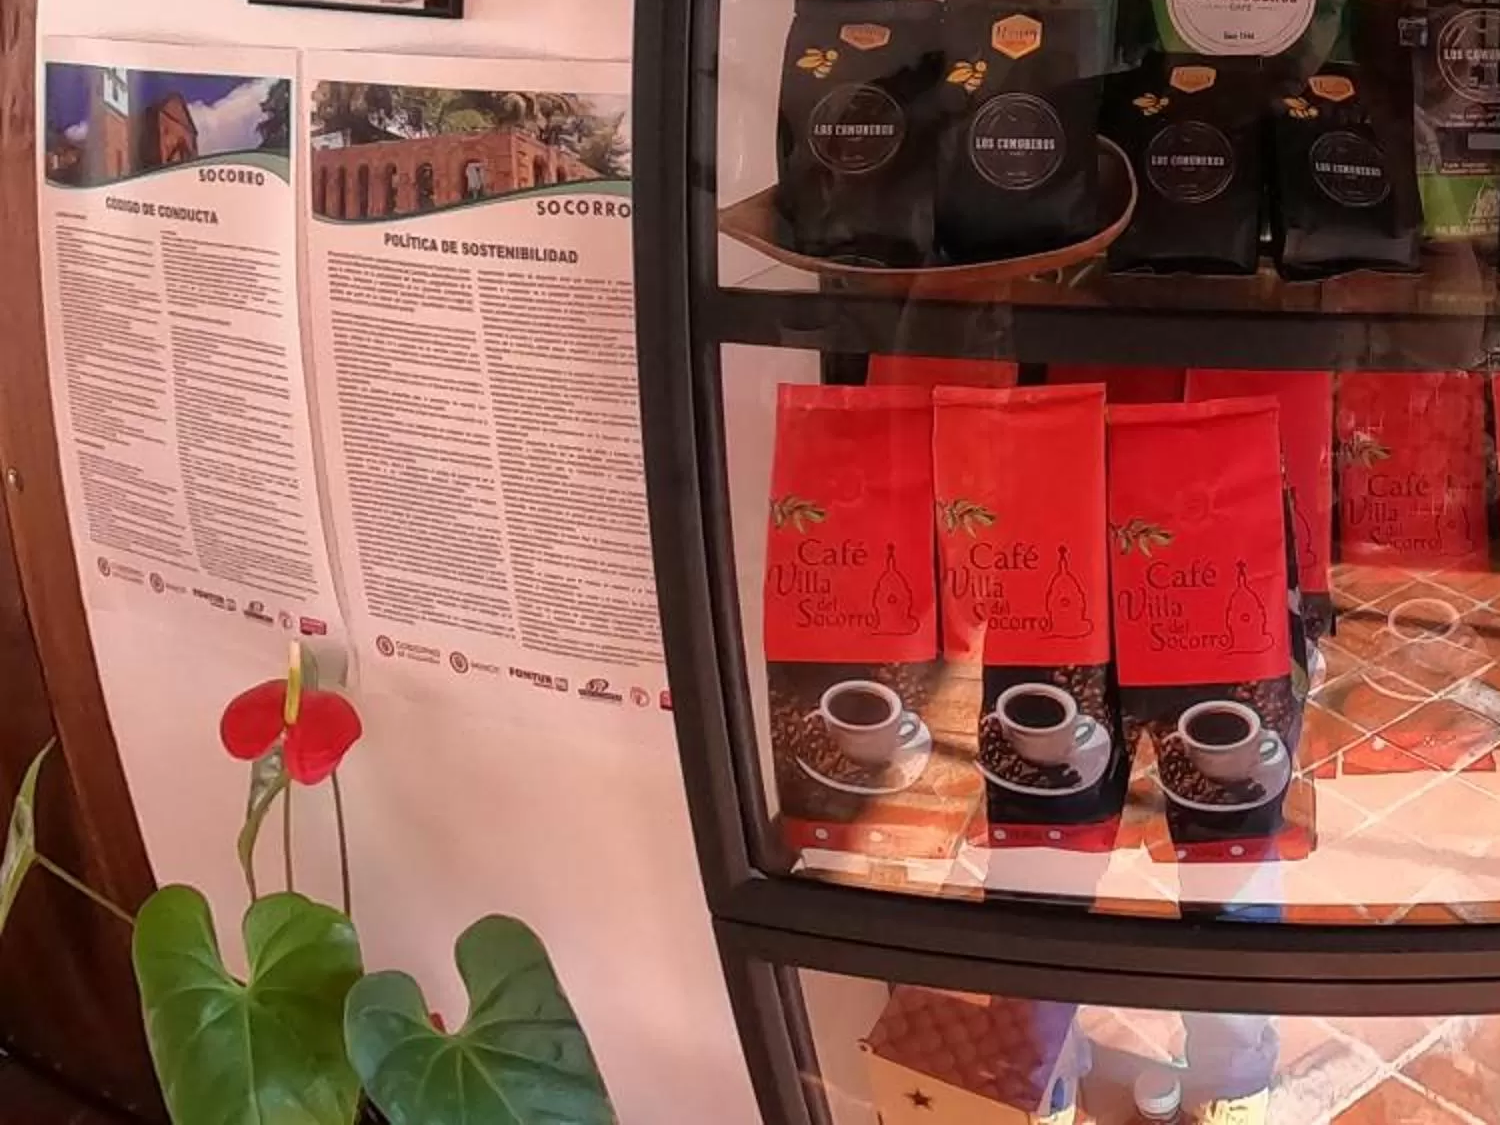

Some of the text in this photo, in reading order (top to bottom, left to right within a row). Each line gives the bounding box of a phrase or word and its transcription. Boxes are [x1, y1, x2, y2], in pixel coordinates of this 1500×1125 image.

[814, 124, 894, 135] LOS COMUNEROS
[976, 137, 1055, 150] LOS COMUNEROS
[198, 168, 265, 186] SOCORRO
[143, 203, 155, 217] DE
[158, 205, 218, 224] CONDUCTA
[537, 200, 631, 218] SOCORRO
[384, 232, 578, 264] POLÍTICA DE SOSTENIBILIDAD
[1368, 474, 1429, 498] Café
[797, 537, 868, 566] Café
[970, 542, 1039, 571] Café
[769, 565, 830, 597] Villa
[945, 566, 1004, 599] Villa
[1147, 561, 1217, 590] Café
[796, 599, 879, 630] Socorro
[817, 599, 837, 612] del
[973, 602, 1052, 633] Socorro
[1119, 588, 1183, 619] Villa
[1150, 622, 1236, 652] Socorro
[1169, 621, 1190, 634] del
